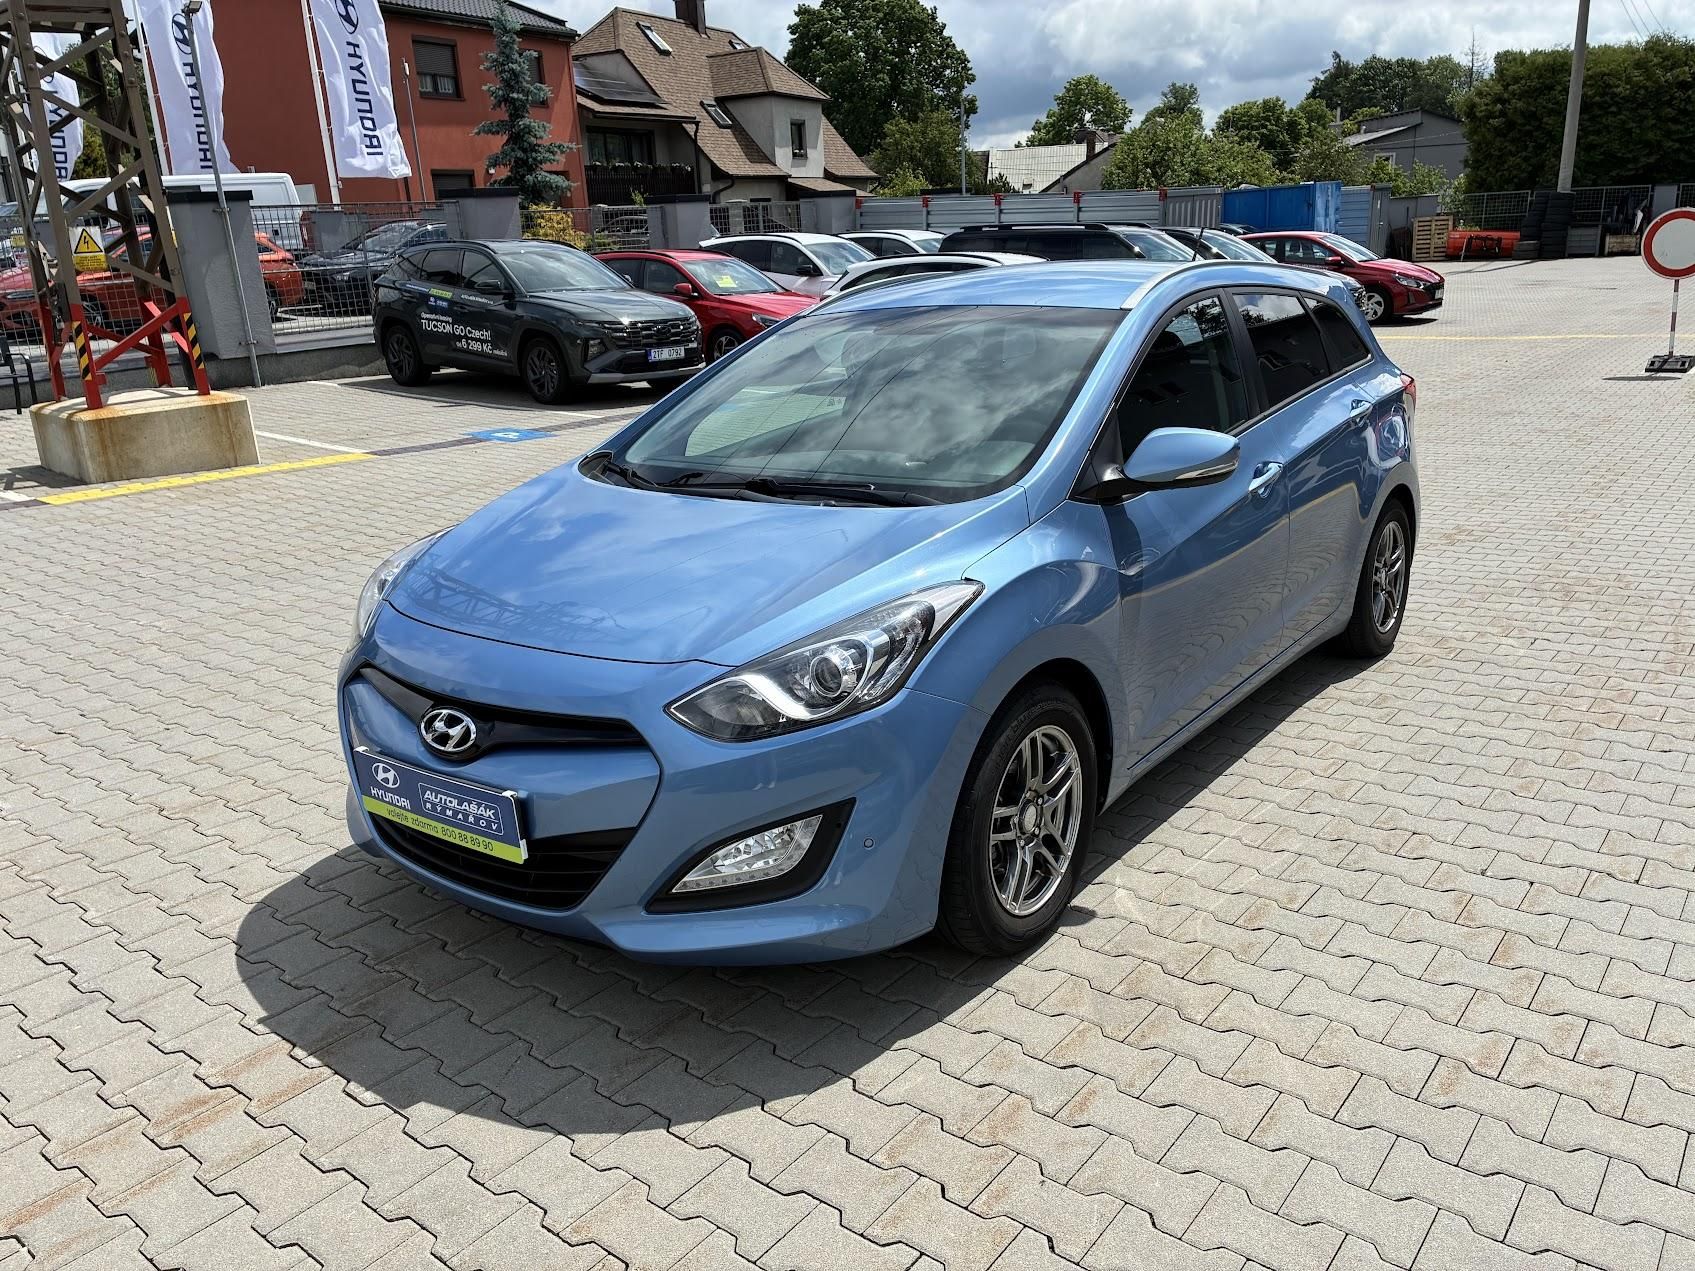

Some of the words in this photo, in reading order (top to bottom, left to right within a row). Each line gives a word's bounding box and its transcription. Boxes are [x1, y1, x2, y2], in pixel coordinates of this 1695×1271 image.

[346, 41, 384, 156] HYUNDAI
[421, 319, 453, 334] TUCSON
[453, 325, 466, 337] GO
[466, 327, 491, 341] Czech!
[461, 338, 468, 349] 6
[467, 340, 482, 351] 299
[482, 342, 493, 354] Kč
[668, 348, 682, 357] 0792
[371, 786, 411, 811] HYUNDAI
[423, 791, 495, 819] AUTOLAŠÁK
[386, 807, 410, 824] volejte
[411, 817, 439, 834] zdarma
[441, 826, 457, 841] 800
[457, 831, 469, 844] 88
[470, 834, 481, 848] 89
[481, 838, 494, 852] 90
[425, 803, 498, 830] RÝMAŘOV
